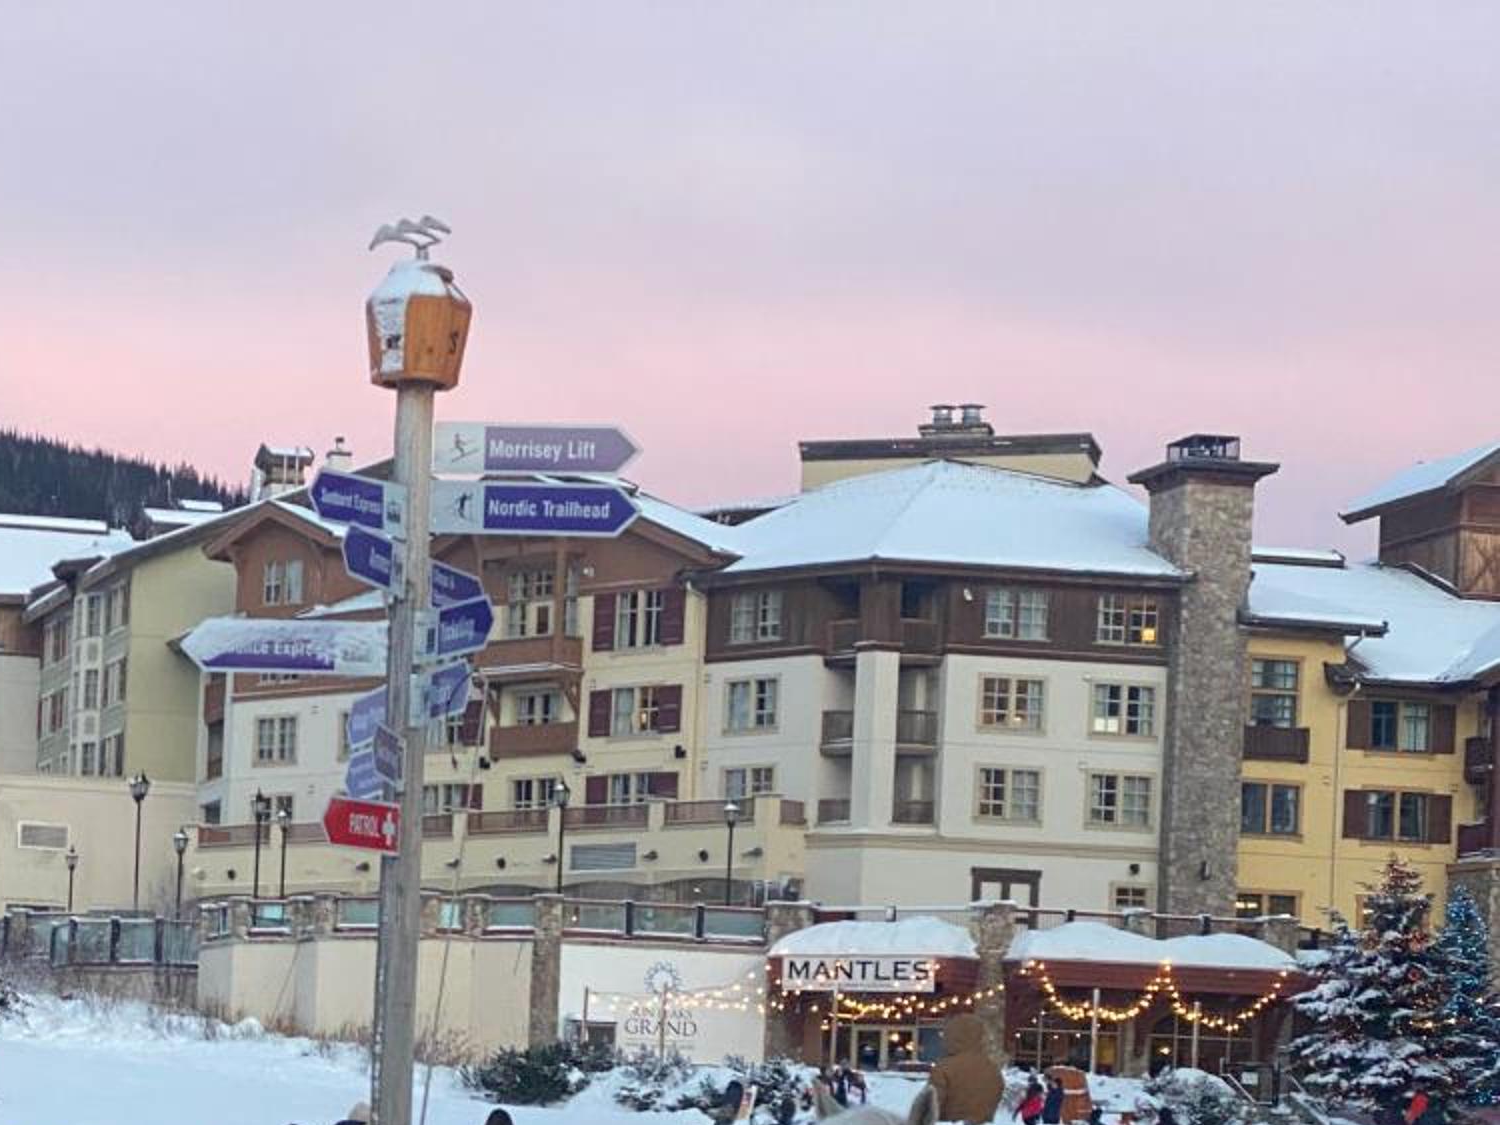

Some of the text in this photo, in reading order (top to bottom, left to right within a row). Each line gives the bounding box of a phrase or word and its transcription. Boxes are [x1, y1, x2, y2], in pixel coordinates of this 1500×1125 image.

[488, 439, 596, 462] Morrisey Lift
[488, 499, 611, 519] Nordic Trailhead
[349, 812, 381, 837] PATROL
[788, 959, 930, 981] MANTLES
[623, 1018, 698, 1037] GRAND
